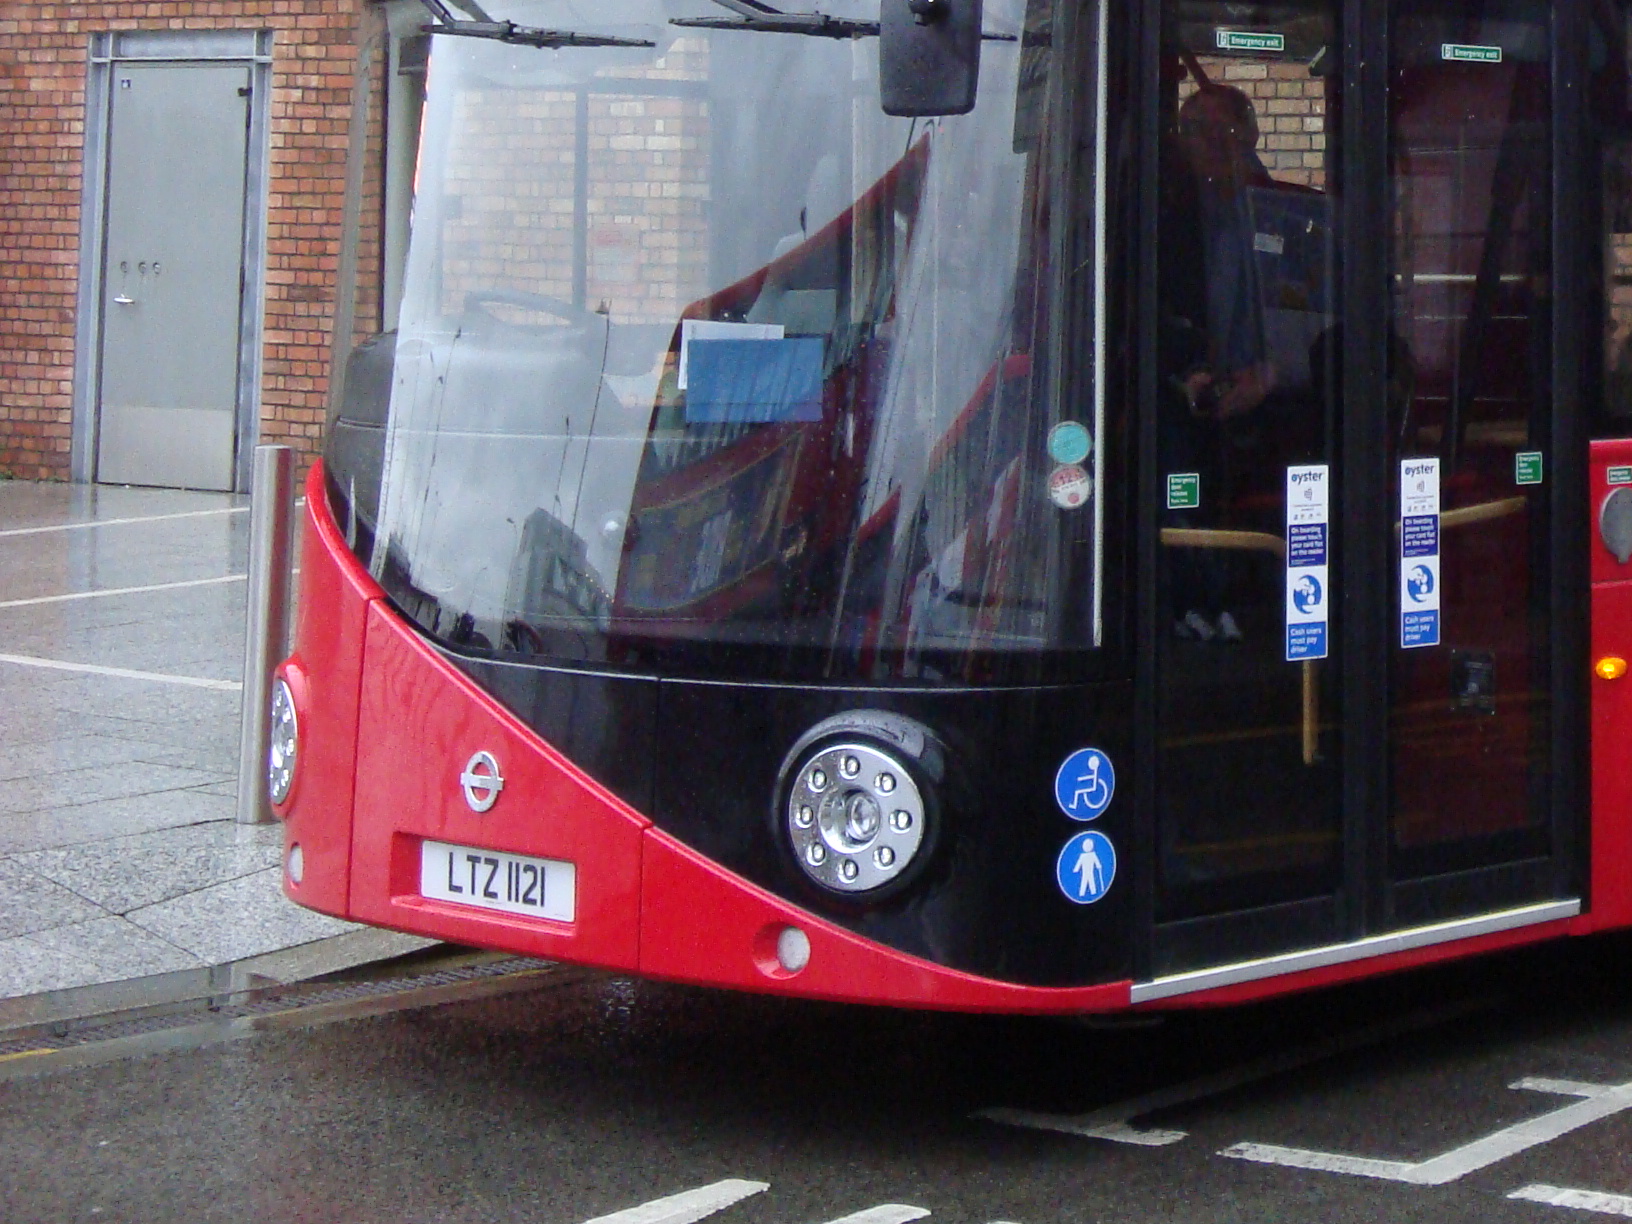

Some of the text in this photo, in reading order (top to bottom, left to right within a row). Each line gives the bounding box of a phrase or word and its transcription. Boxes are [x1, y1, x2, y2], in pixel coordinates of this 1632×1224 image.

[1231, 36, 1280, 47] Emergency exit
[1454, 48, 1499, 60] Emergency exit
[1405, 463, 1435, 477] oyster
[1291, 470, 1323, 485] oyster
[448, 851, 546, 907] LTZ 1121
